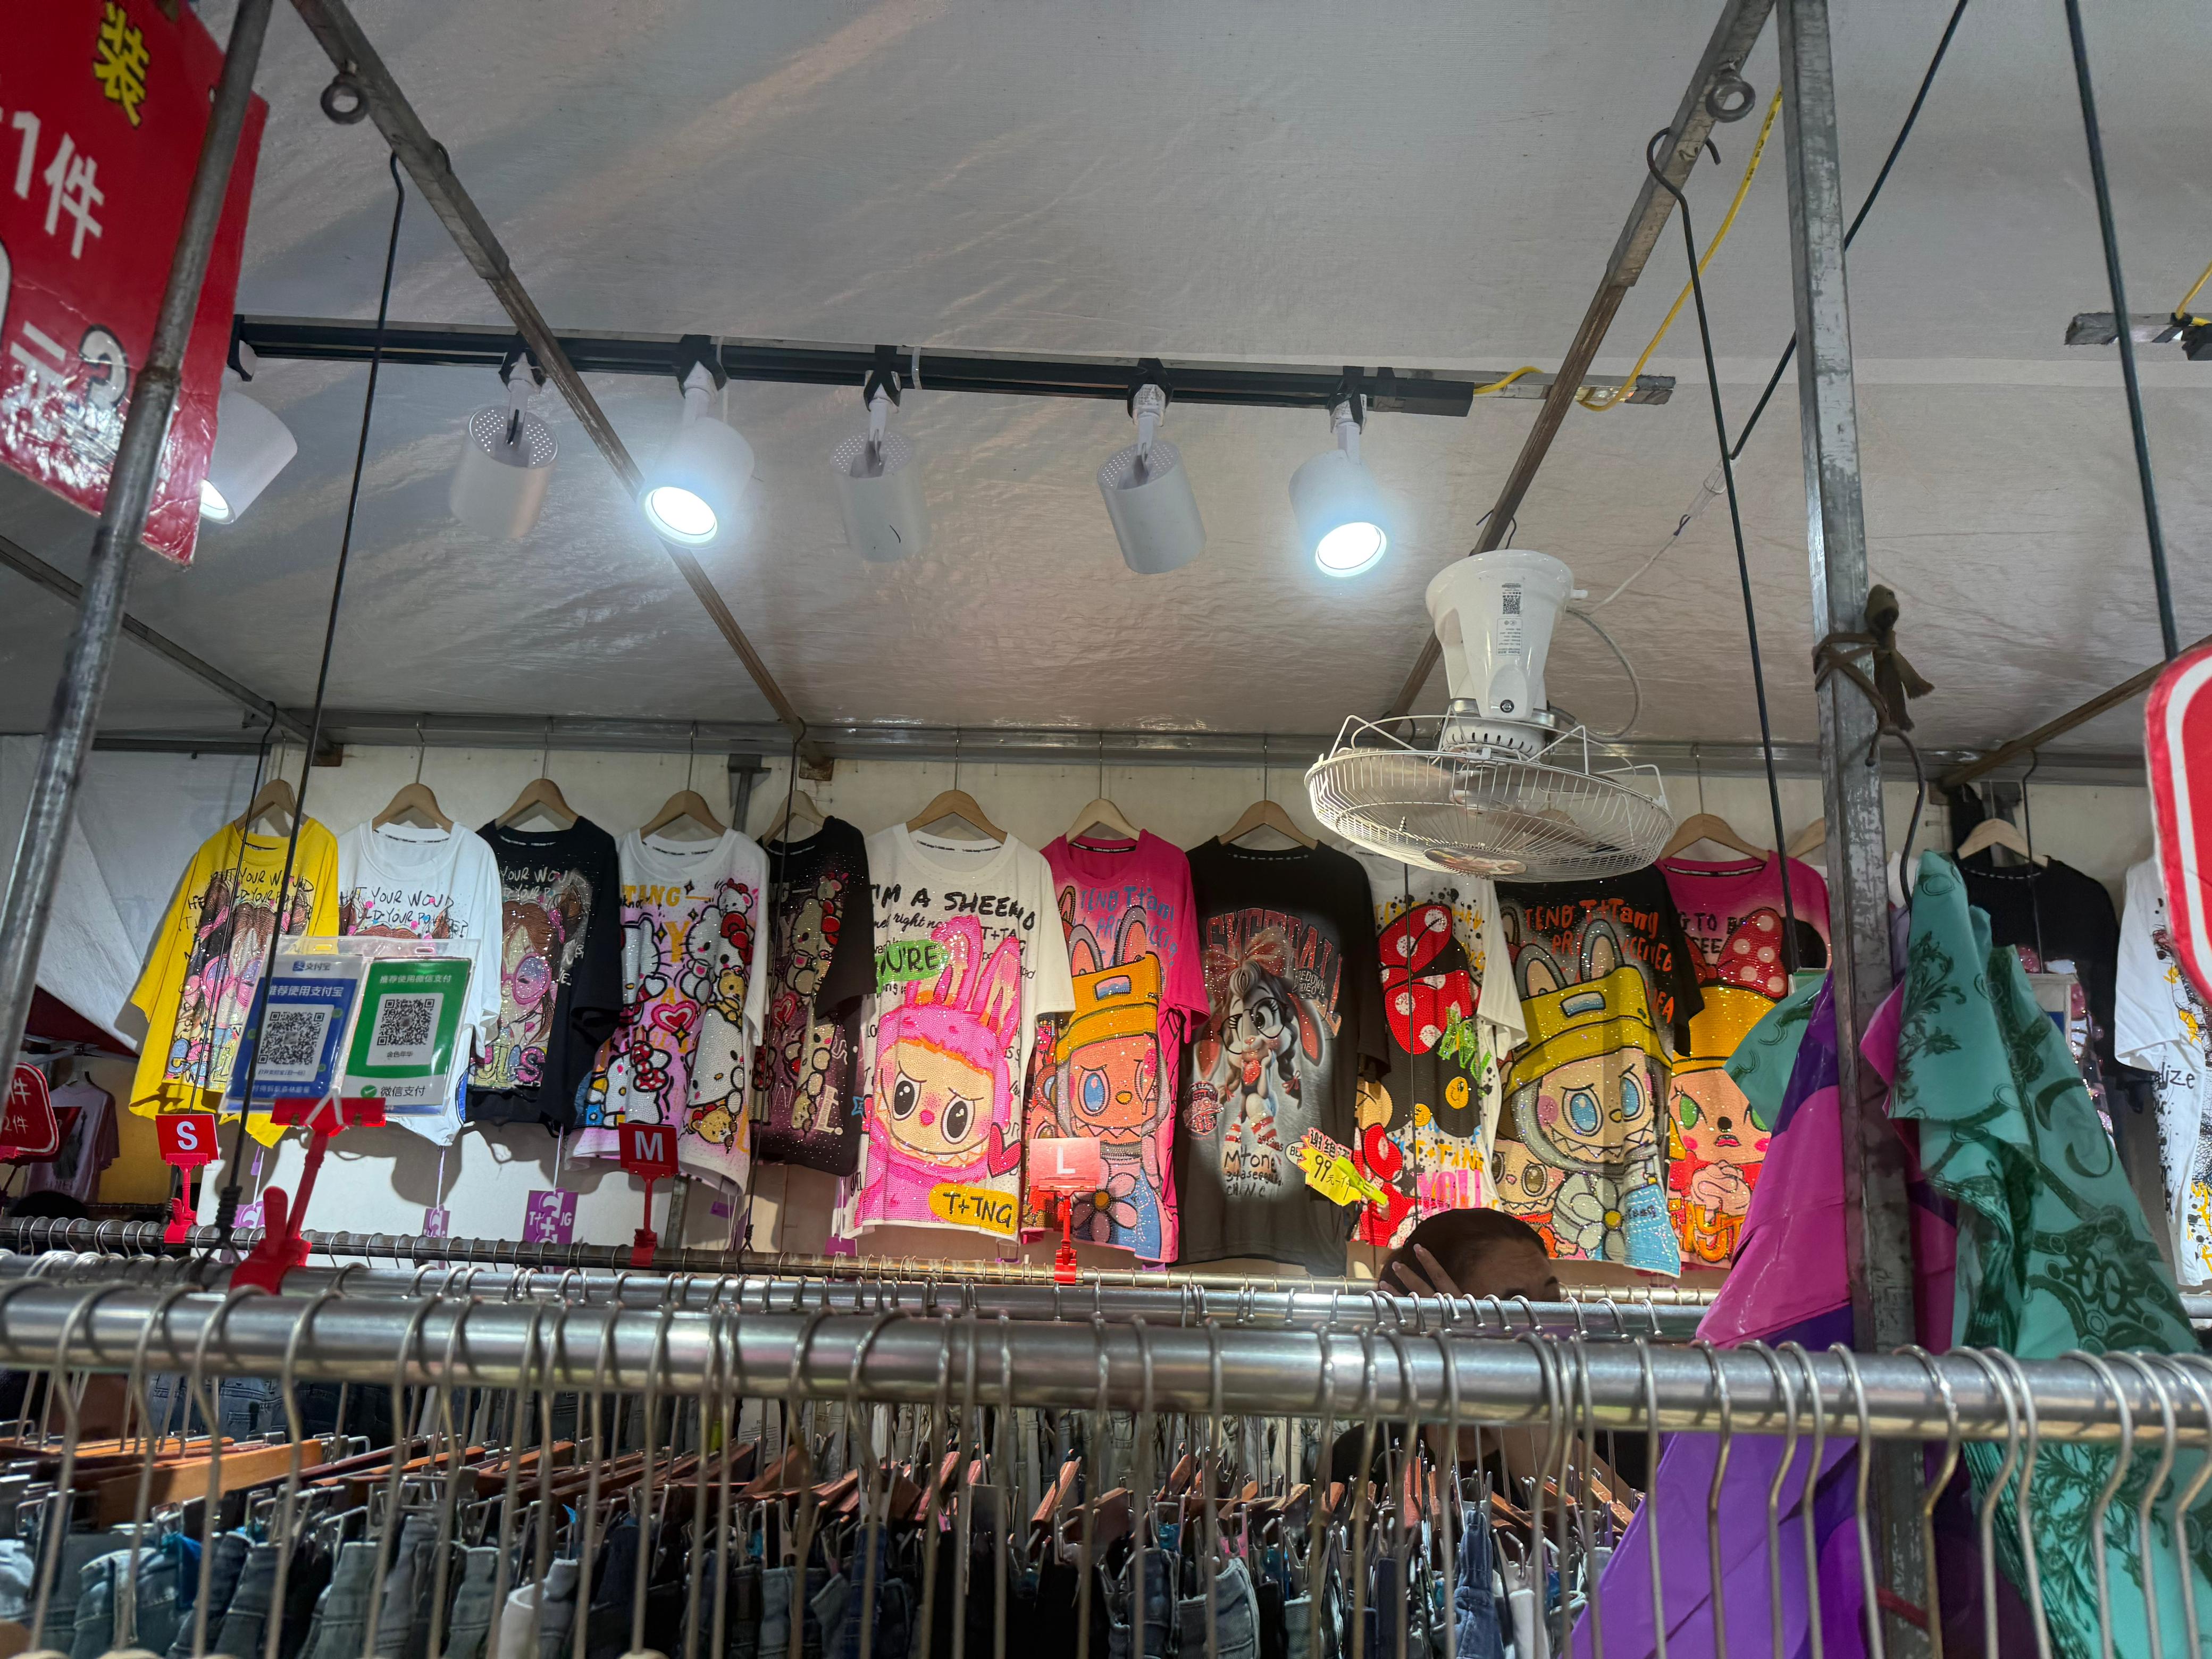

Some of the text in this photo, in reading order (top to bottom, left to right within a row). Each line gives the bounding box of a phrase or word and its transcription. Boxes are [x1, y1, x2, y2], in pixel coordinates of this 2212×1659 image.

[371, 886, 402, 905] YOUR
[910, 887, 932, 908] A
[386, 908, 413, 924] YOUR
[893, 912, 926, 932] right
[380, 1086, 426, 1097] 微信支付
[177, 1121, 198, 1150] S
[634, 1130, 664, 1162] M
[1057, 1145, 1076, 1174] L
